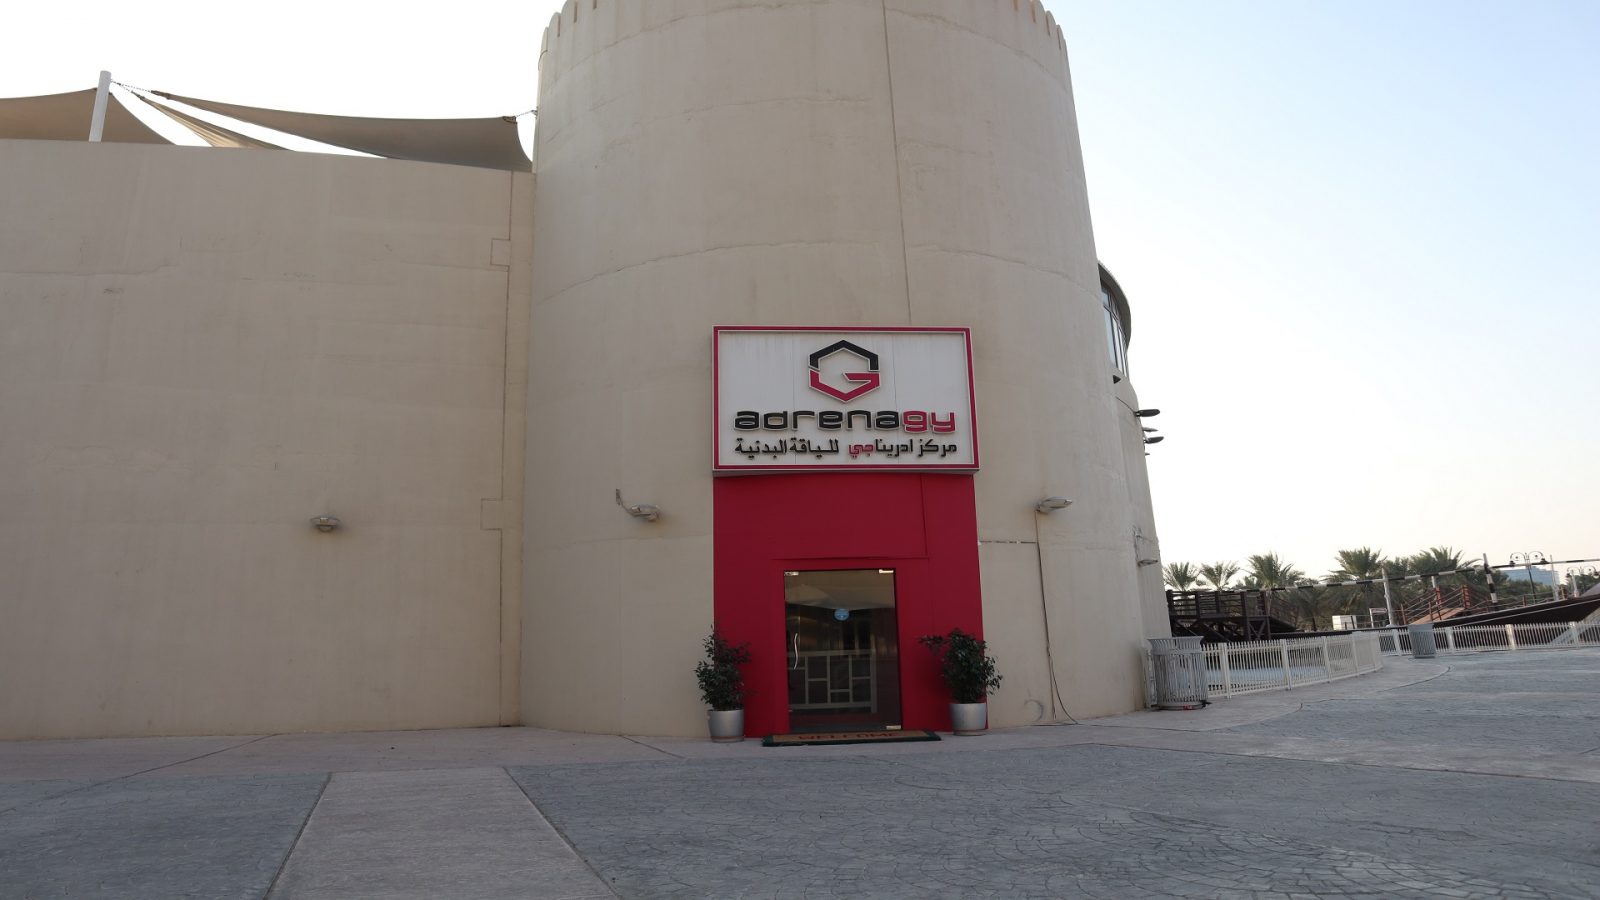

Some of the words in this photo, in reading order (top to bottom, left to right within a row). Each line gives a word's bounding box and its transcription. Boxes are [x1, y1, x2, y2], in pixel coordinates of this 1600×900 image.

[734, 409, 956, 433] adrenagy
[734, 437, 788, 459] البدنية
[789, 437, 839, 458] للياقة
[848, 438, 914, 459] ادريناجي
[918, 438, 957, 457] مركز
